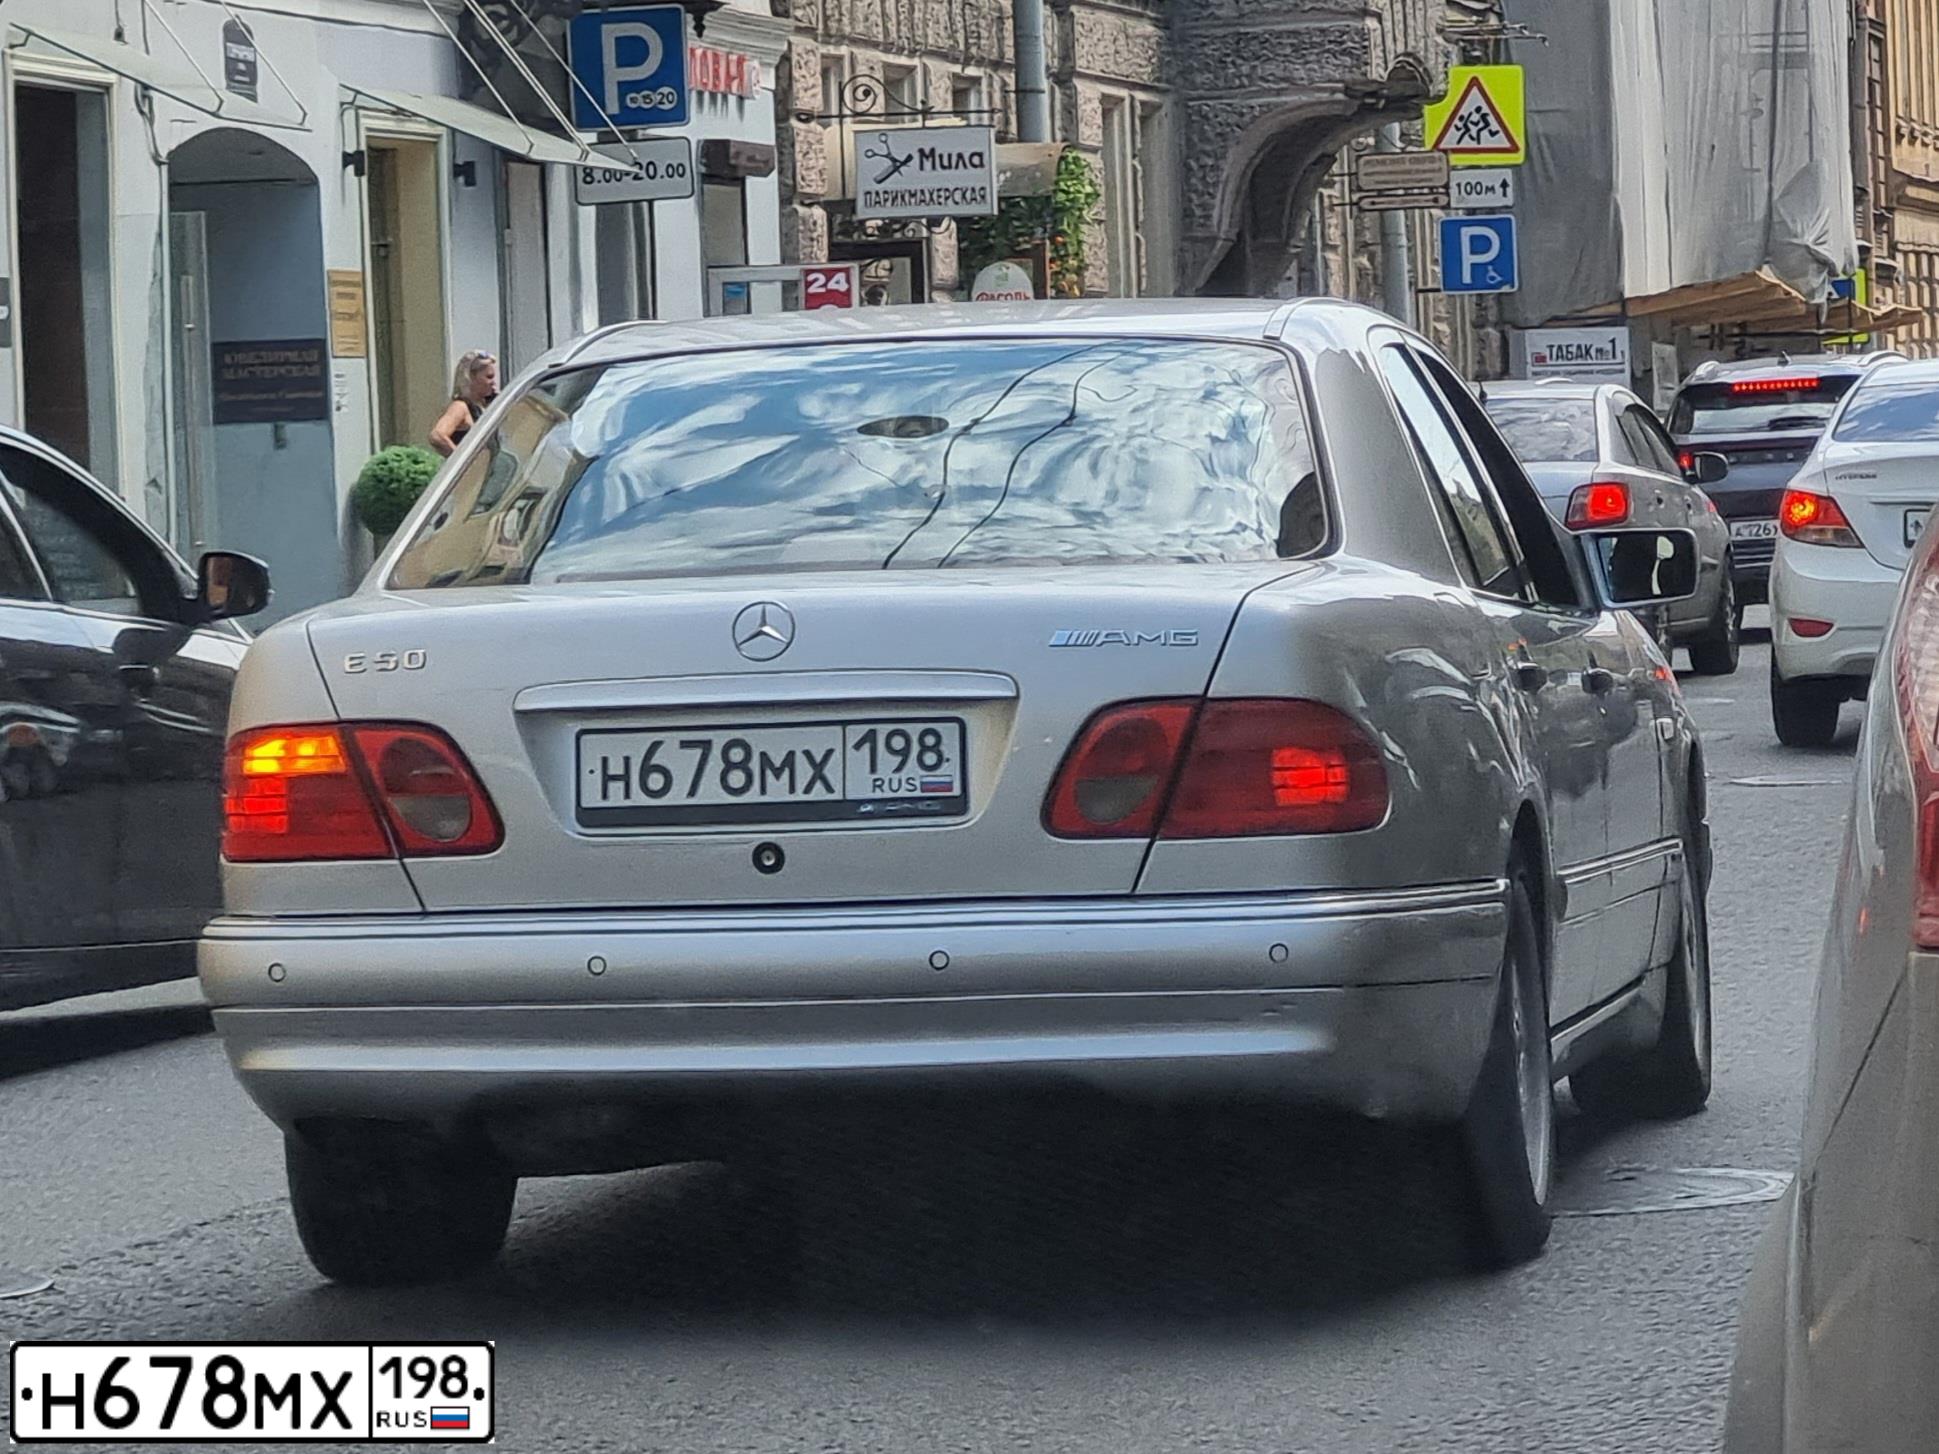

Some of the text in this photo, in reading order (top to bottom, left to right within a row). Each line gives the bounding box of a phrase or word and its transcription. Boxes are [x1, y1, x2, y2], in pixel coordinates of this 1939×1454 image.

[601, 22, 664, 115] P
[657, 91, 675, 105] 20
[918, 146, 985, 171] Мила
[864, 186, 988, 209] ПАРИКМАХЕРСКАЯ
[1460, 226, 1501, 284] P
[807, 272, 849, 293] 24
[1546, 344, 1594, 362] ТАБАК
[851, 727, 944, 774] 198
[872, 776, 918, 794] RUS
